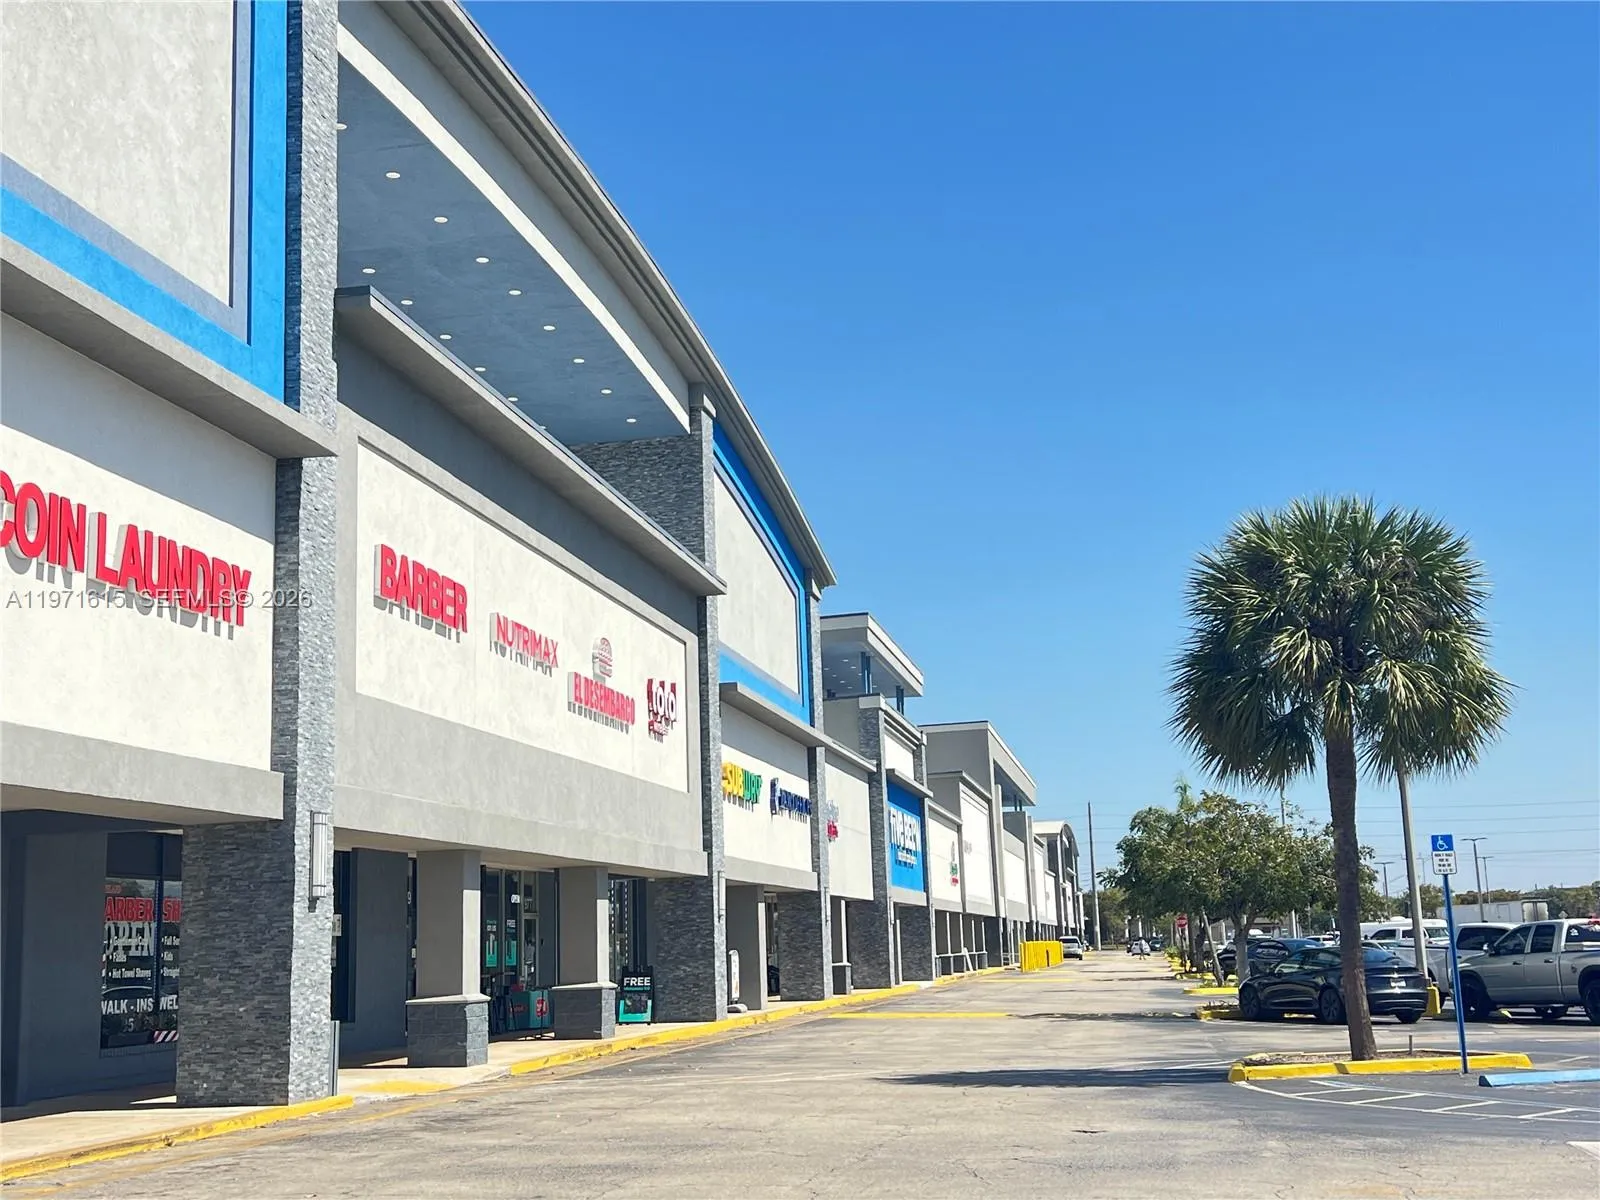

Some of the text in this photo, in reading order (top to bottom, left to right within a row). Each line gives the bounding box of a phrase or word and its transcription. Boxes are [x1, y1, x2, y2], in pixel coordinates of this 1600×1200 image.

[94, 511, 251, 627] LAUNDRY
[378, 543, 468, 634] BARBER
[494, 611, 559, 669] NUTRIMAX
[623, 976, 651, 986] FREE
